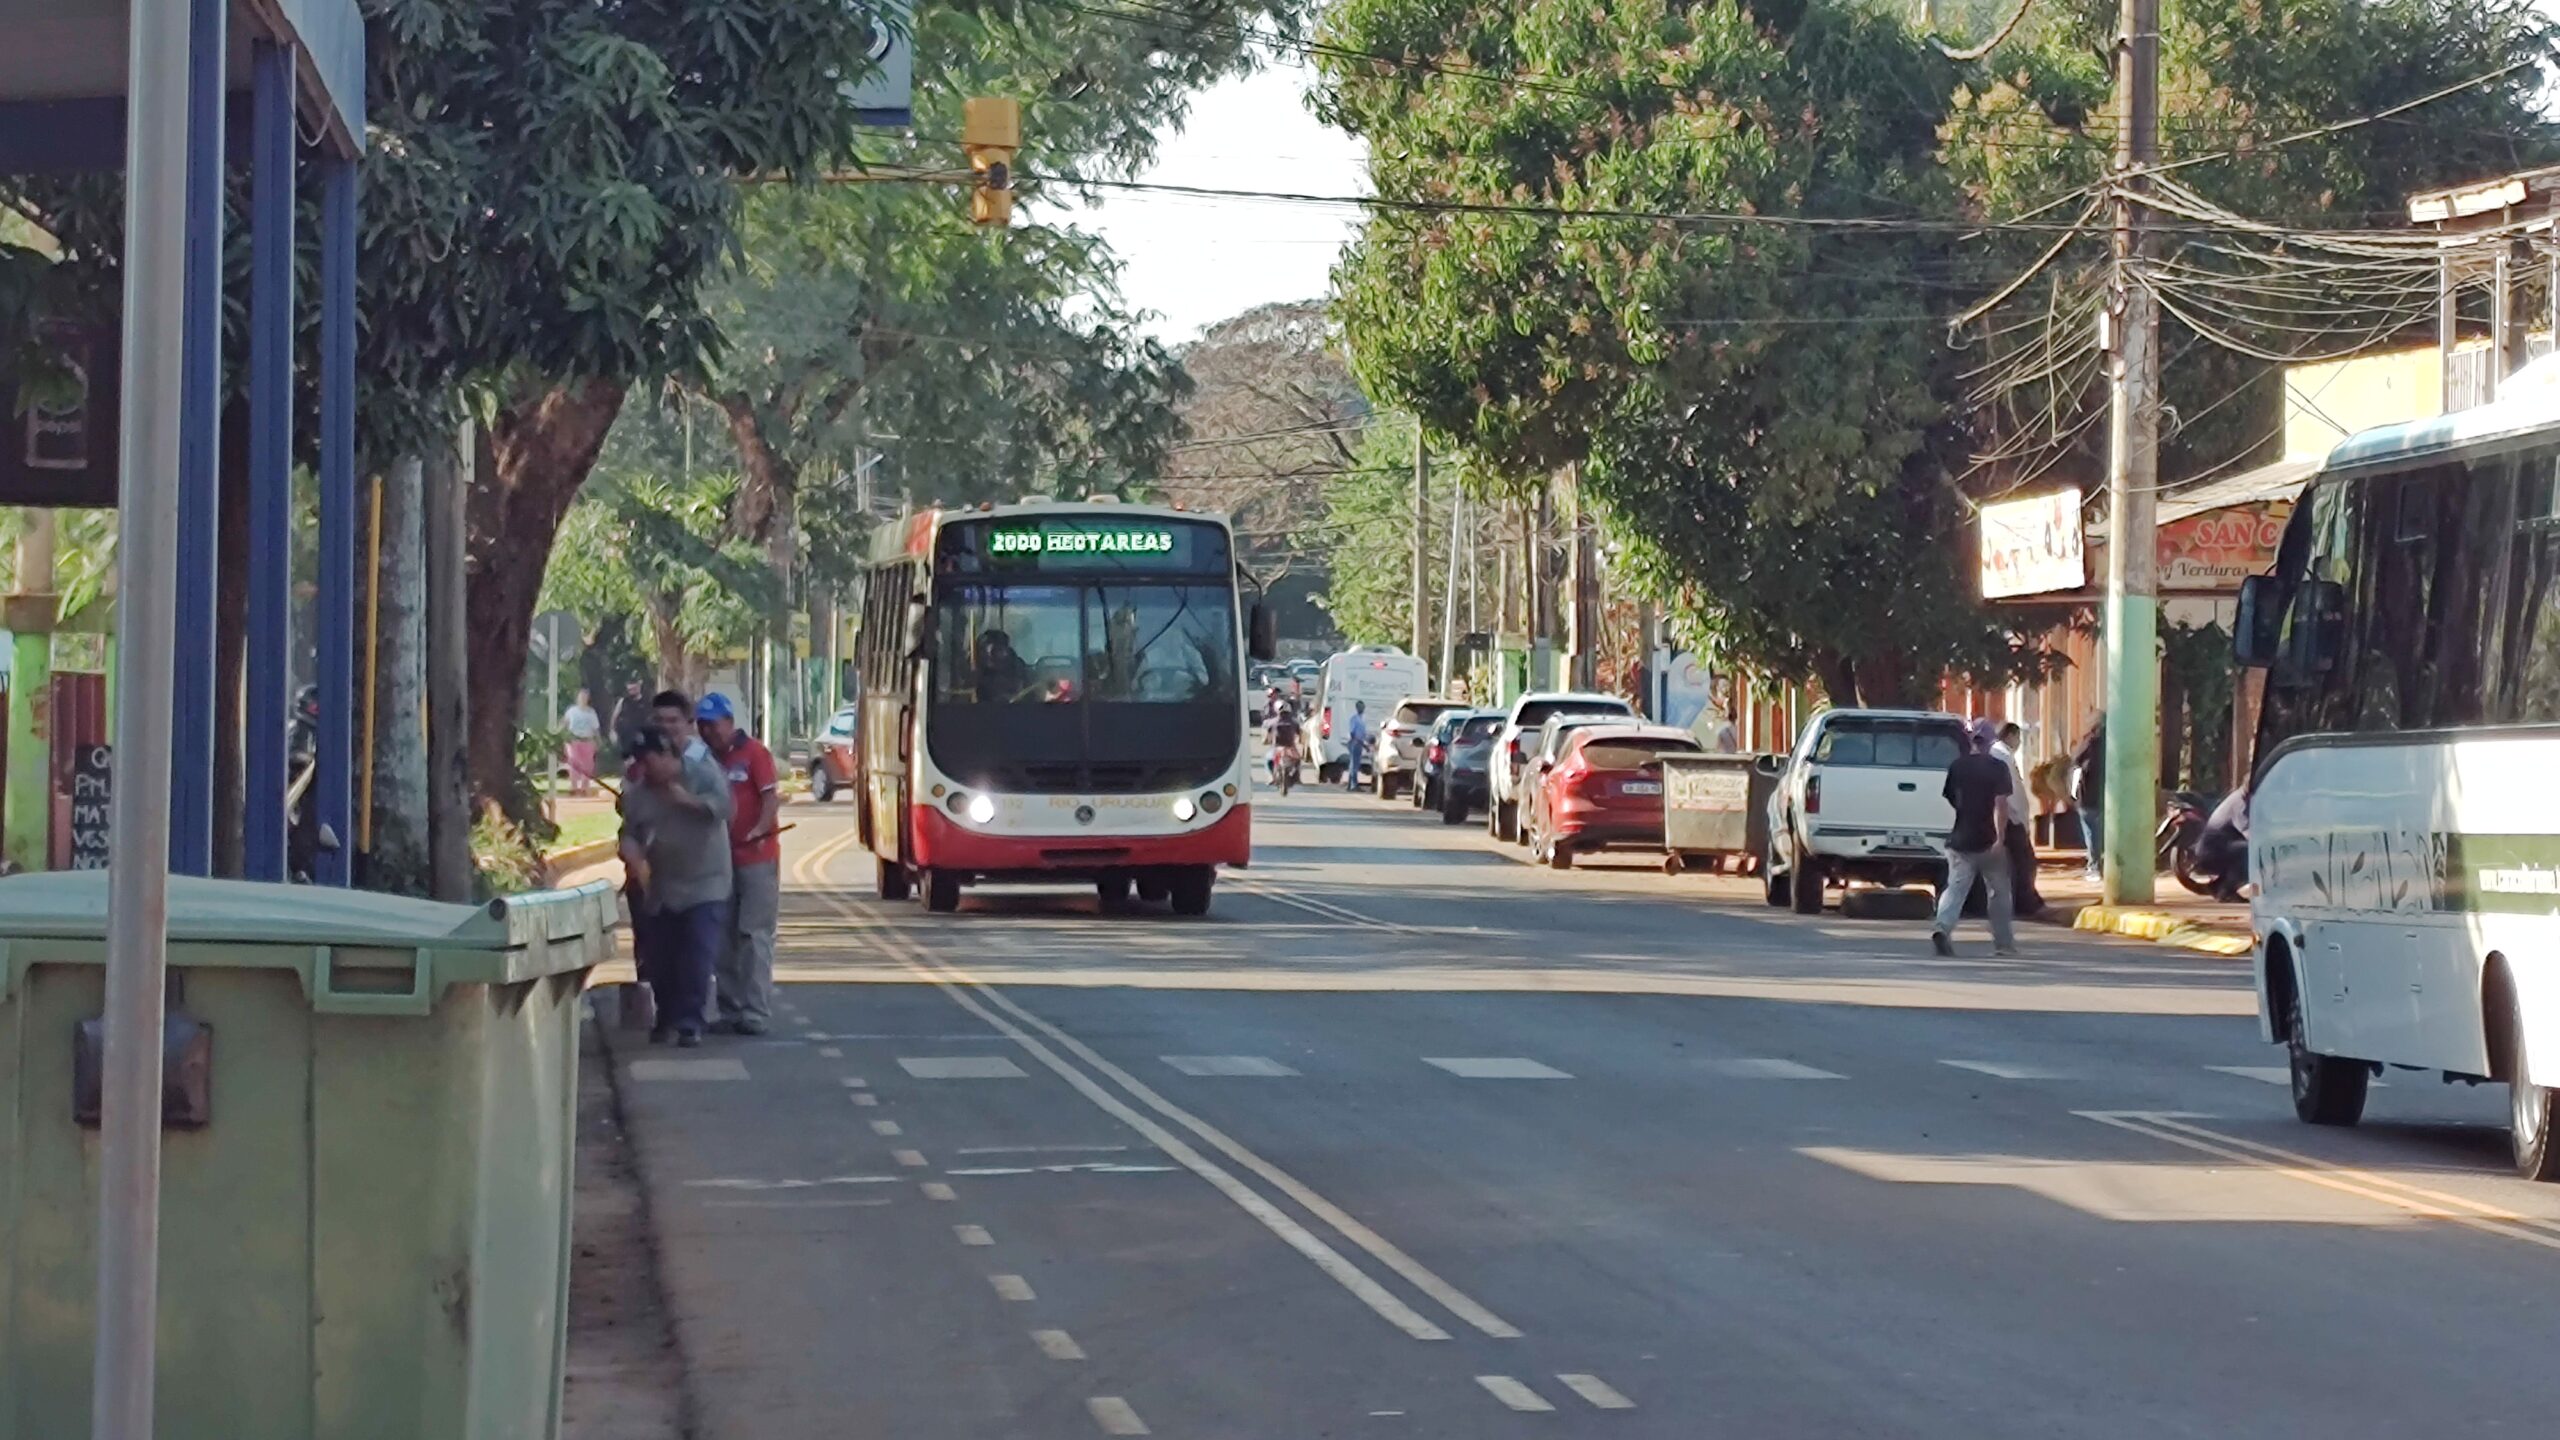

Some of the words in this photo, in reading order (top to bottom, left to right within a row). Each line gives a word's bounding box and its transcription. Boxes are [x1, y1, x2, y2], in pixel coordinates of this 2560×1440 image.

[992, 532, 1042, 551] 2000
[1047, 532, 1172, 551] HECTAREAS
[2196, 519, 2255, 547] SAN
[2259, 521, 2278, 546] C
[2178, 562, 2249, 576] Verduras
[1092, 796, 1174, 808] URUGUA
[75, 804, 112, 824] MAT
